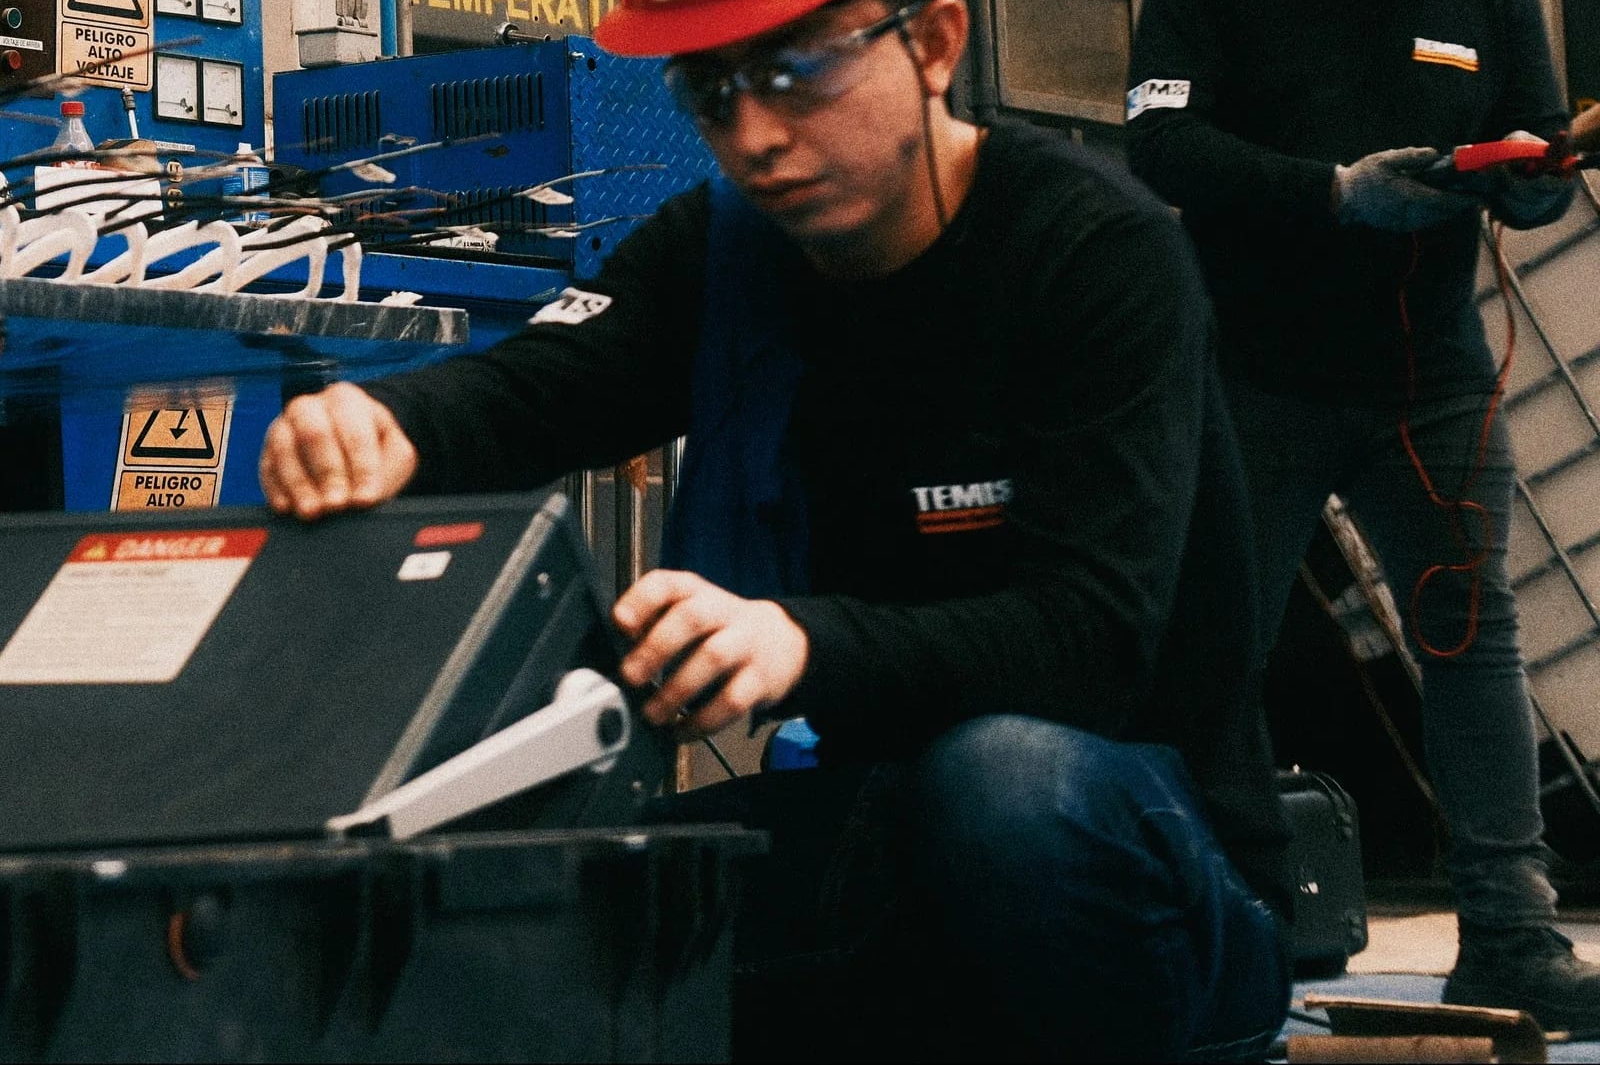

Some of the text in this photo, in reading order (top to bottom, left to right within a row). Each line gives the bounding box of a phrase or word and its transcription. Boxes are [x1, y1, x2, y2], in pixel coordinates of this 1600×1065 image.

[75, 27, 136, 48] PELIGRO
[87, 45, 122, 61] ALTO
[76, 60, 134, 80] VOLTAJE
[134, 475, 203, 491] PELIGRO
[145, 493, 186, 508] ALTO
[112, 535, 227, 559] DANGER
